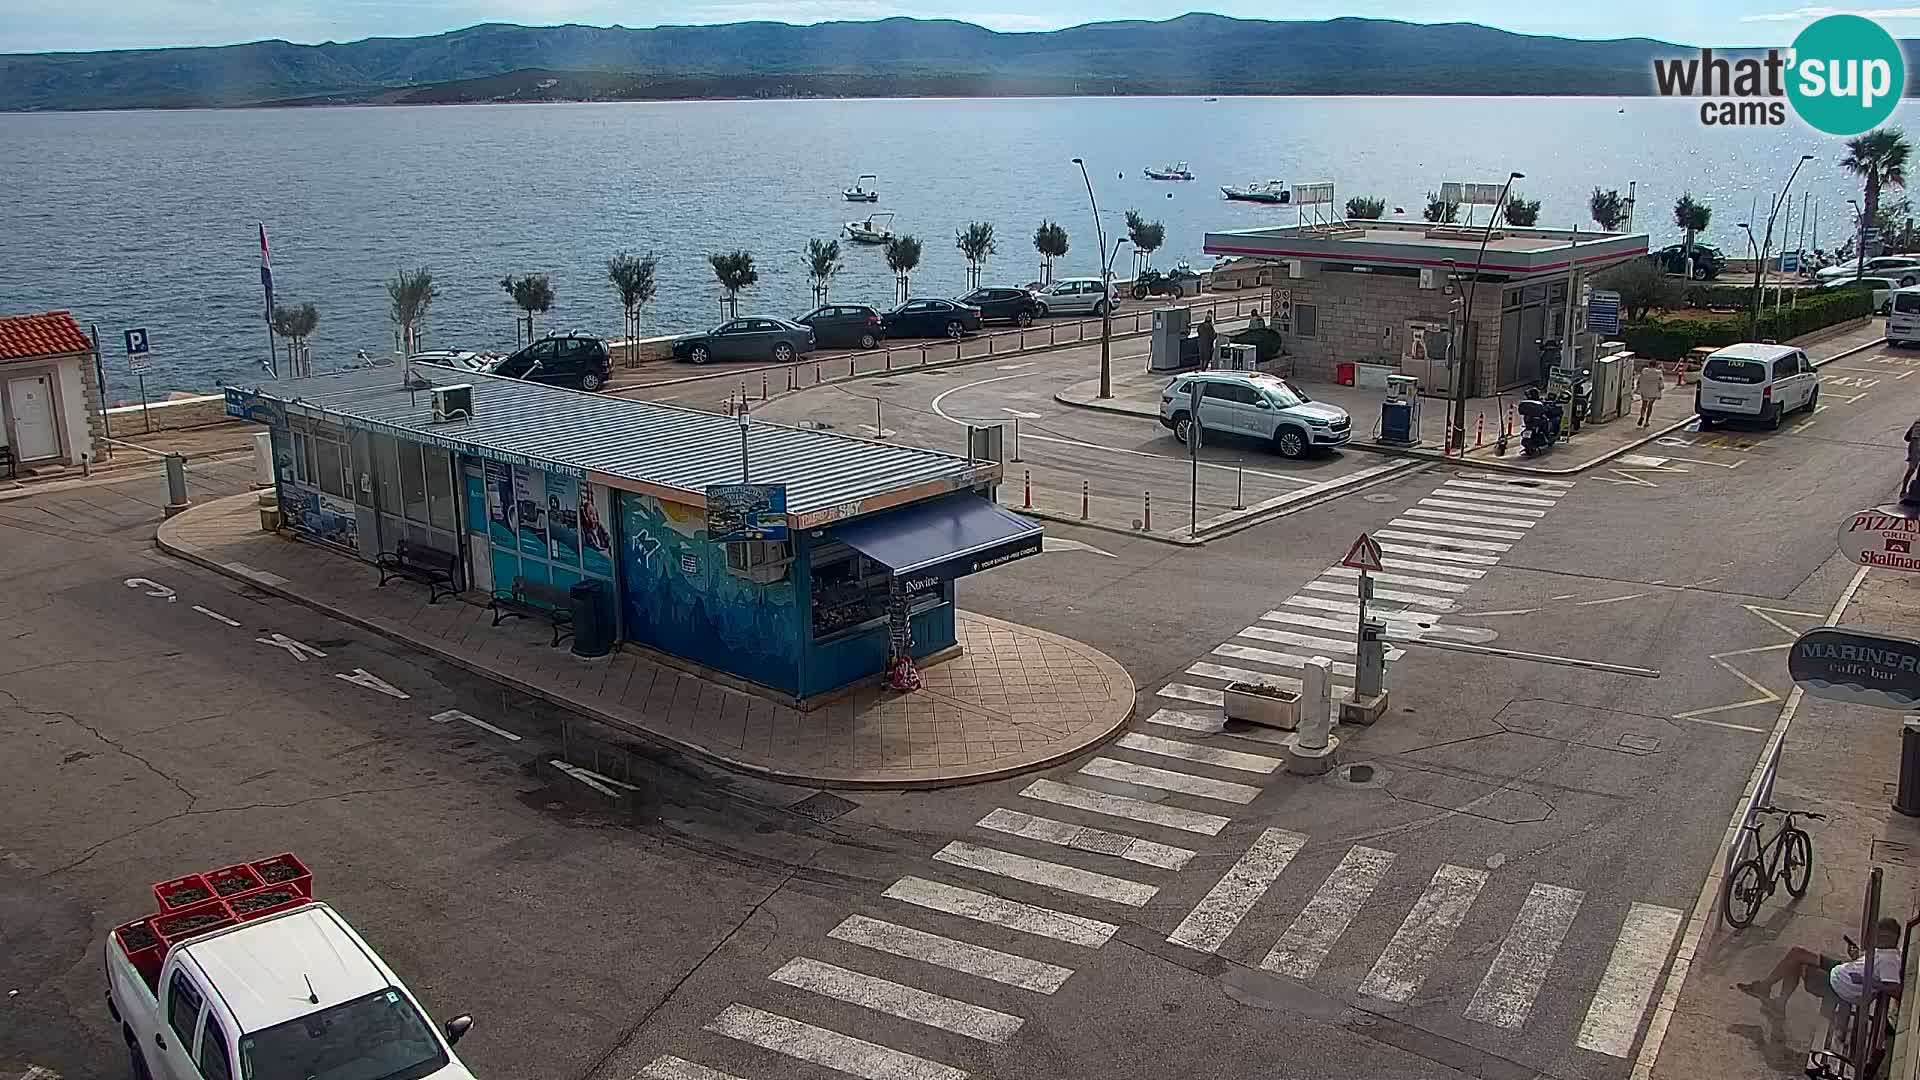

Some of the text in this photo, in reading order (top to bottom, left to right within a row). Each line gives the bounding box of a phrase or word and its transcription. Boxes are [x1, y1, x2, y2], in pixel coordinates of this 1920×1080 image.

[130, 332, 143, 350] P
[1727, 359, 1745, 368] TAXI
[478, 447, 493, 459] BUS
[494, 449, 526, 466] STATION
[528, 456, 554, 474] TICKET
[556, 464, 582, 478] OFFICE
[1848, 515, 1920, 534] PIZZE
[1870, 667, 1897, 681] bar
